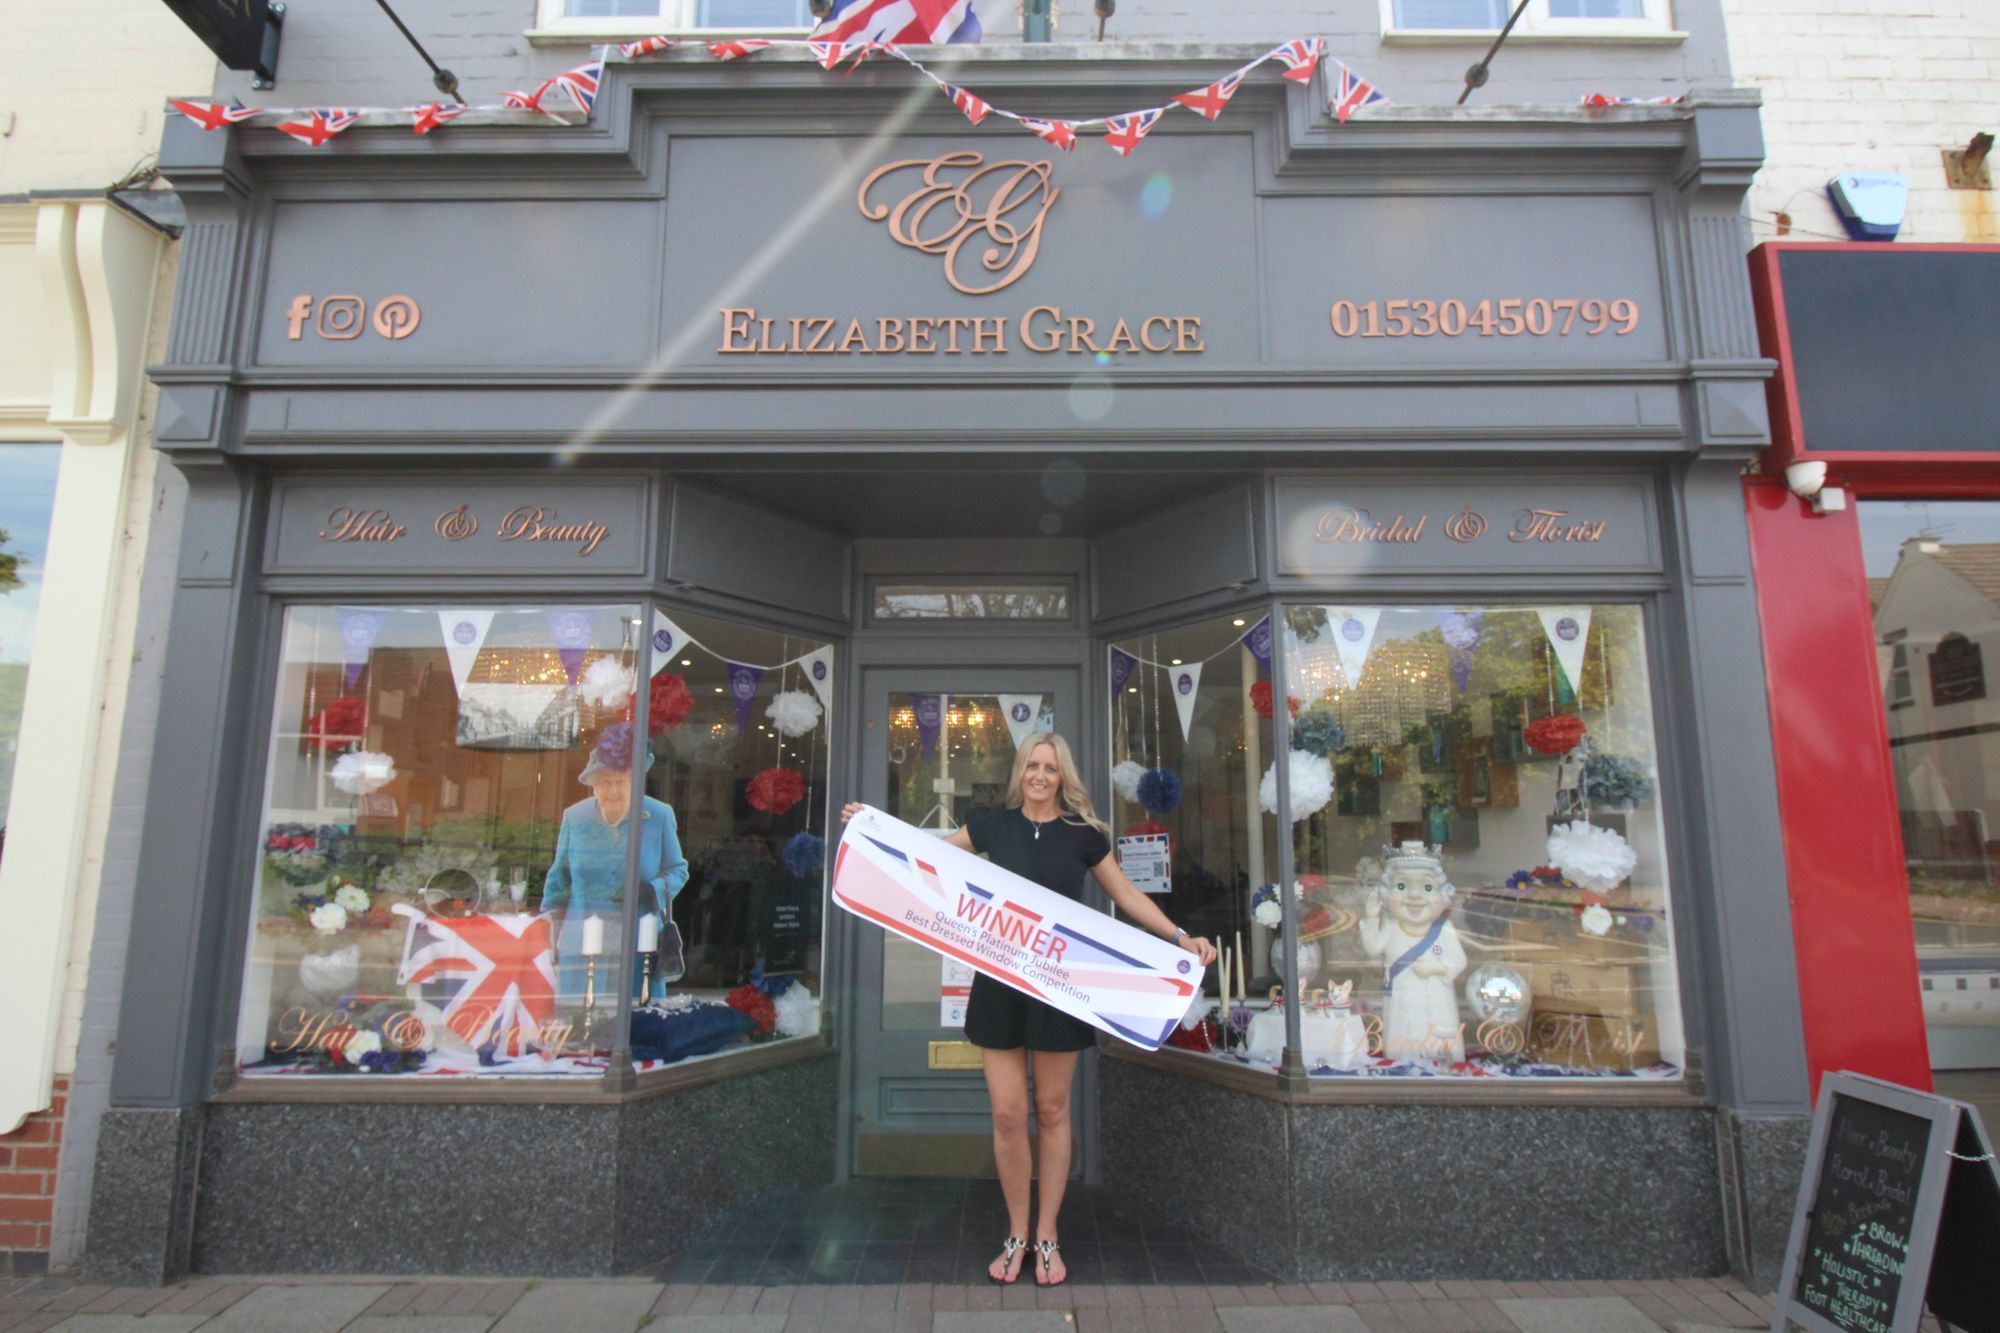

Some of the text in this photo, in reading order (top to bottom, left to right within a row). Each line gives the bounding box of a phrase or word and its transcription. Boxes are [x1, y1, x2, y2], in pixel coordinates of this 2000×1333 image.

[716, 305, 1205, 354] ELIZABETH GRACE
[1330, 298, 1639, 338] 01530450799
[319, 503, 611, 558] Hair & Beauty
[1314, 505, 1608, 544] Bridal & Florist
[935, 910, 1071, 981] Queen's Platinum Jubilee
[956, 892, 1069, 964] WINNER
[905, 909, 1091, 1004] Best Dressed Window Competition
[270, 1006, 366, 1052] Hai
[382, 1010, 427, 1051] &
[1476, 1015, 1526, 1056] &
[1850, 1231, 1905, 1276] THREADIN
[1868, 1221, 1904, 1249] BROW
[1821, 1252, 1869, 1290] HOLISTIC
[1804, 1284, 1829, 1308] FOOT
[1836, 1281, 1881, 1315] THERAPY
